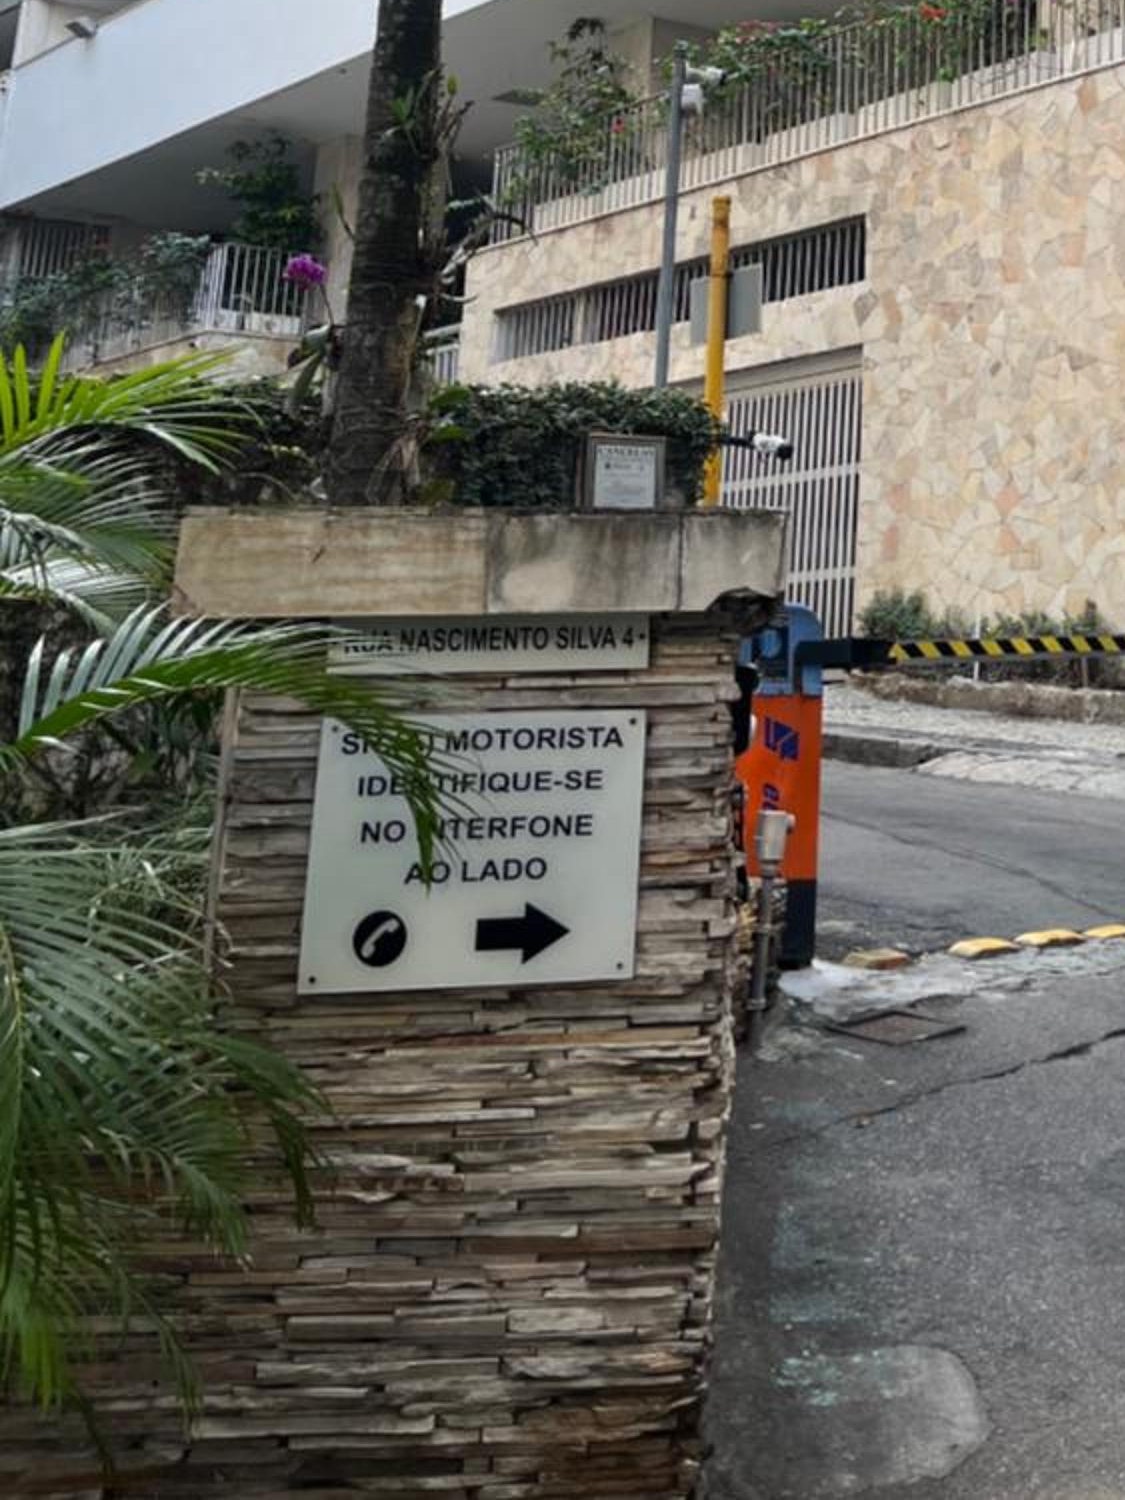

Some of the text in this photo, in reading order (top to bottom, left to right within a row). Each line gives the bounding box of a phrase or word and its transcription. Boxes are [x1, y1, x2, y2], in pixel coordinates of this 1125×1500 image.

[398, 626, 550, 653] NASCIMENTO
[555, 625, 617, 650] SILVA
[445, 726, 624, 752] MOTORISTA
[360, 819, 406, 844] NO
[404, 857, 548, 886] AO LADO
